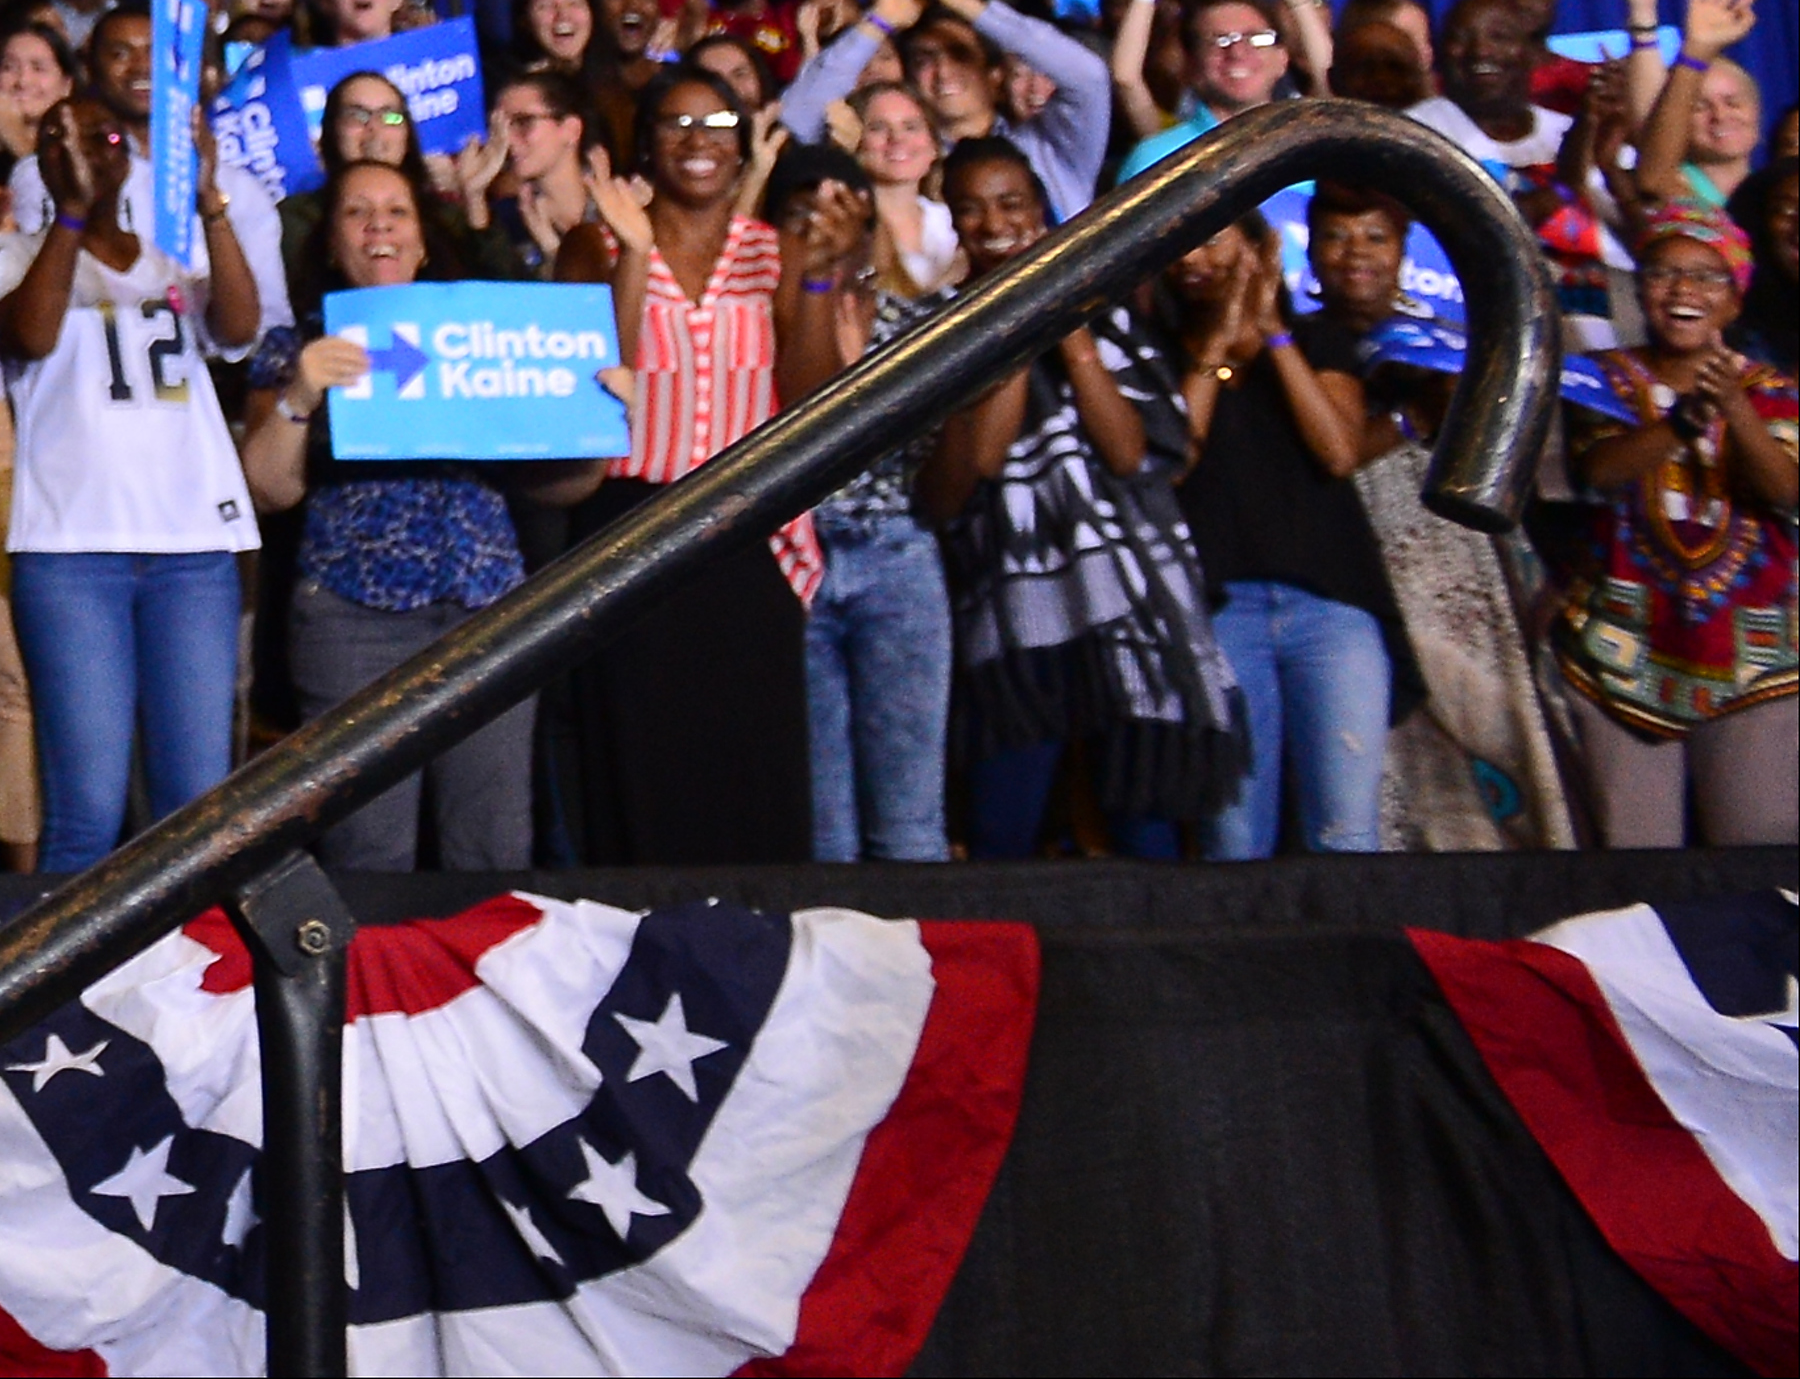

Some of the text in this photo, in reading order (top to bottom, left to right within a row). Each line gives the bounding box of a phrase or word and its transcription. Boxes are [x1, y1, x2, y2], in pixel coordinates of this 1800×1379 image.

[99, 300, 190, 403] 12
[432, 321, 607, 360] Clinton
[438, 360, 578, 399] Kaine
